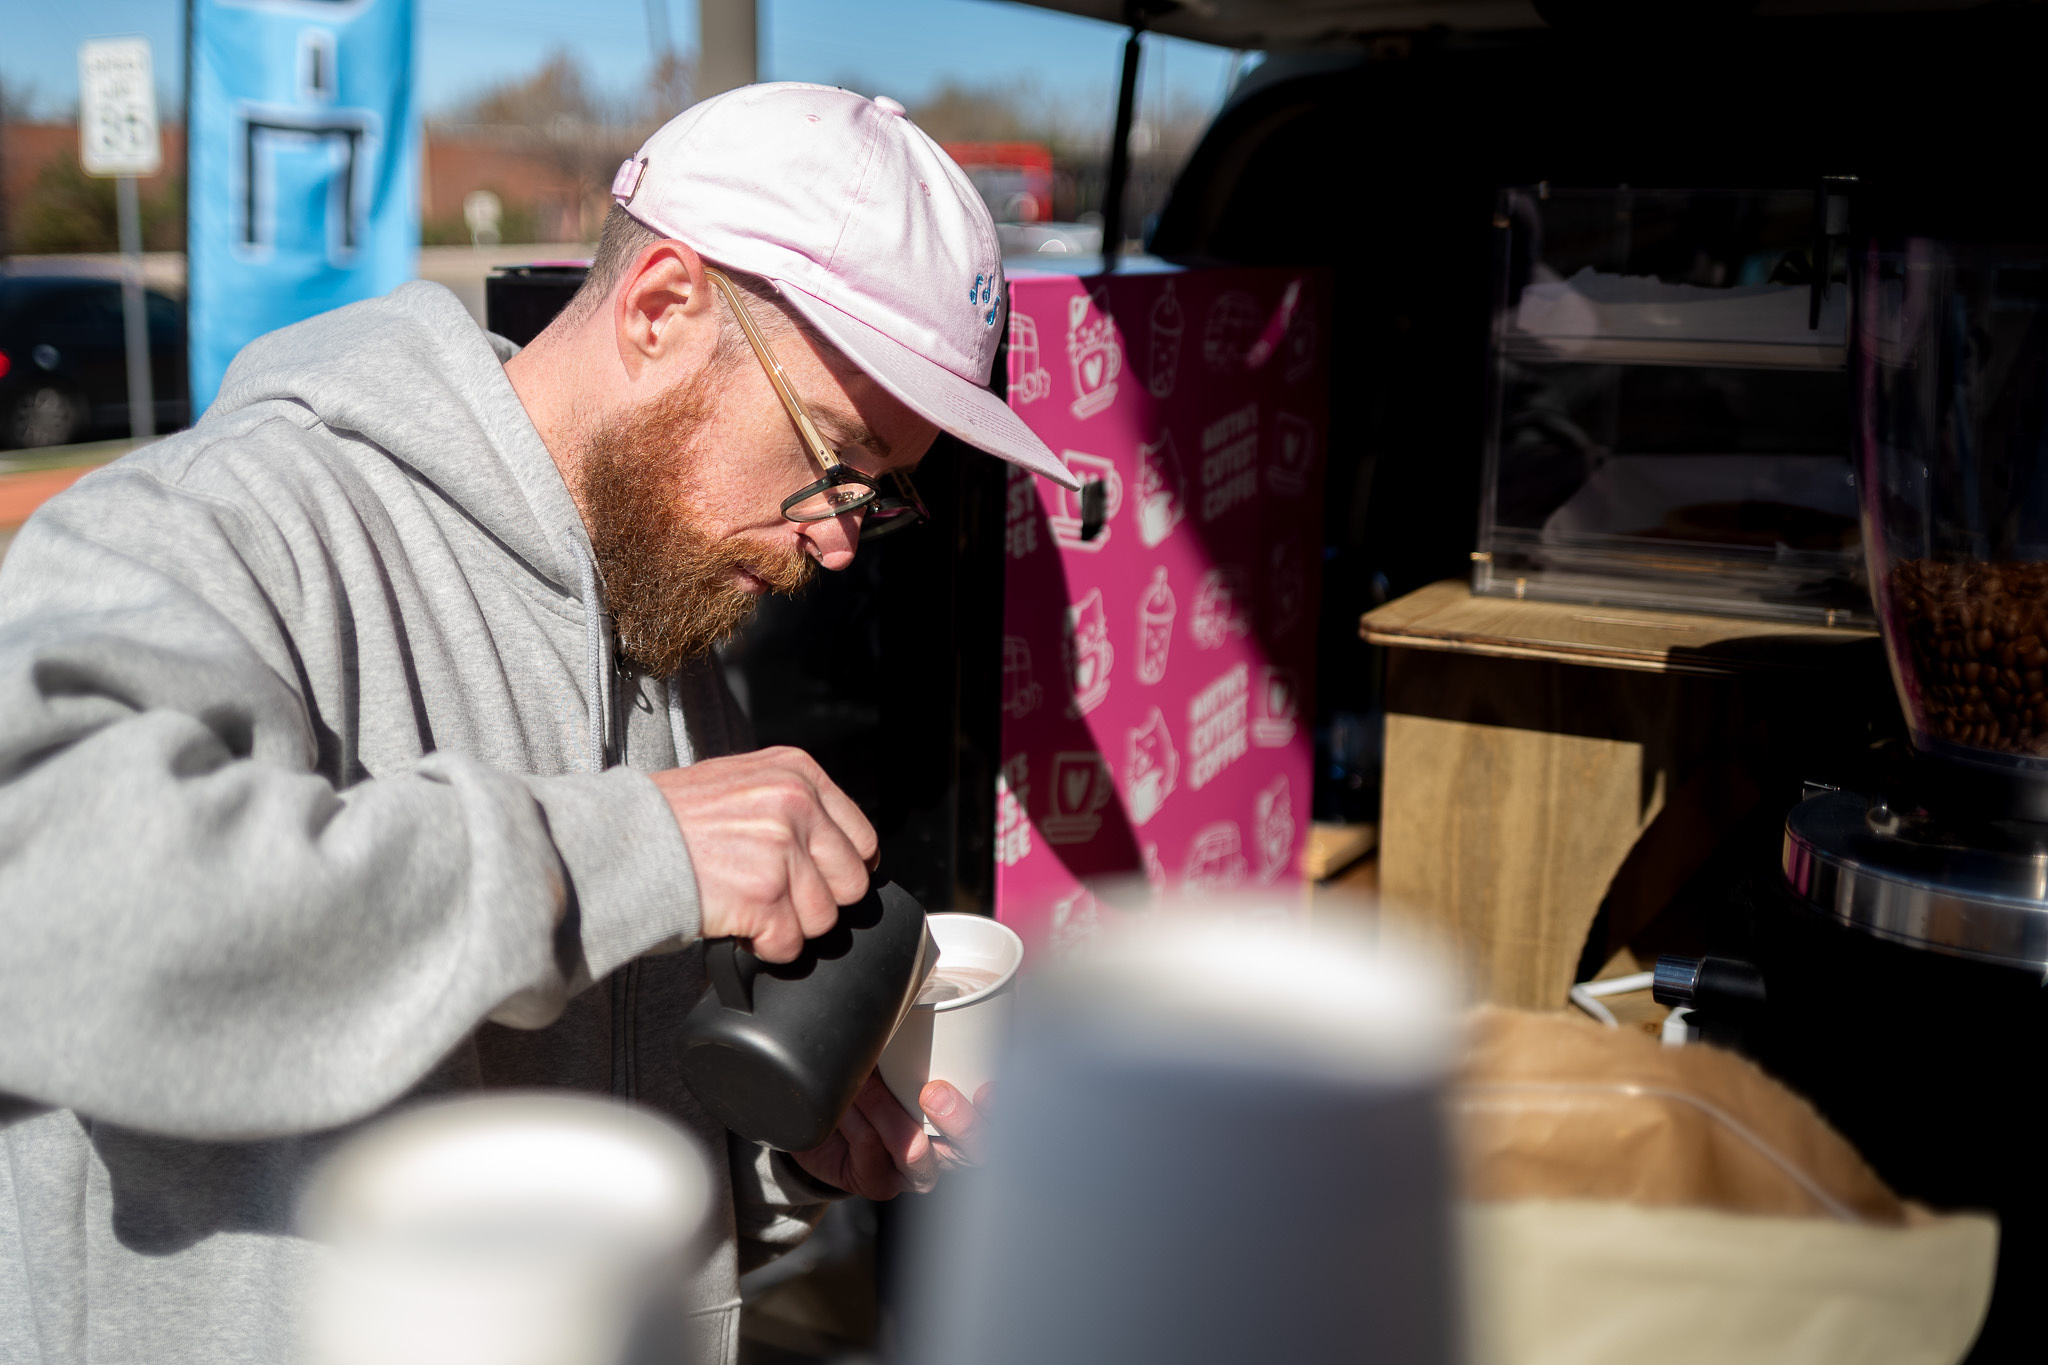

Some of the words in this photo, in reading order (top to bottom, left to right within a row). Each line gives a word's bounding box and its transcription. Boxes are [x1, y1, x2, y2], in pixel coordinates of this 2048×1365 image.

[1201, 433, 1260, 487] CUTEST
[1201, 468, 1258, 522] COFFEE
[1190, 691, 1250, 757] CUTEST
[1190, 725, 1249, 791] COFFEE
